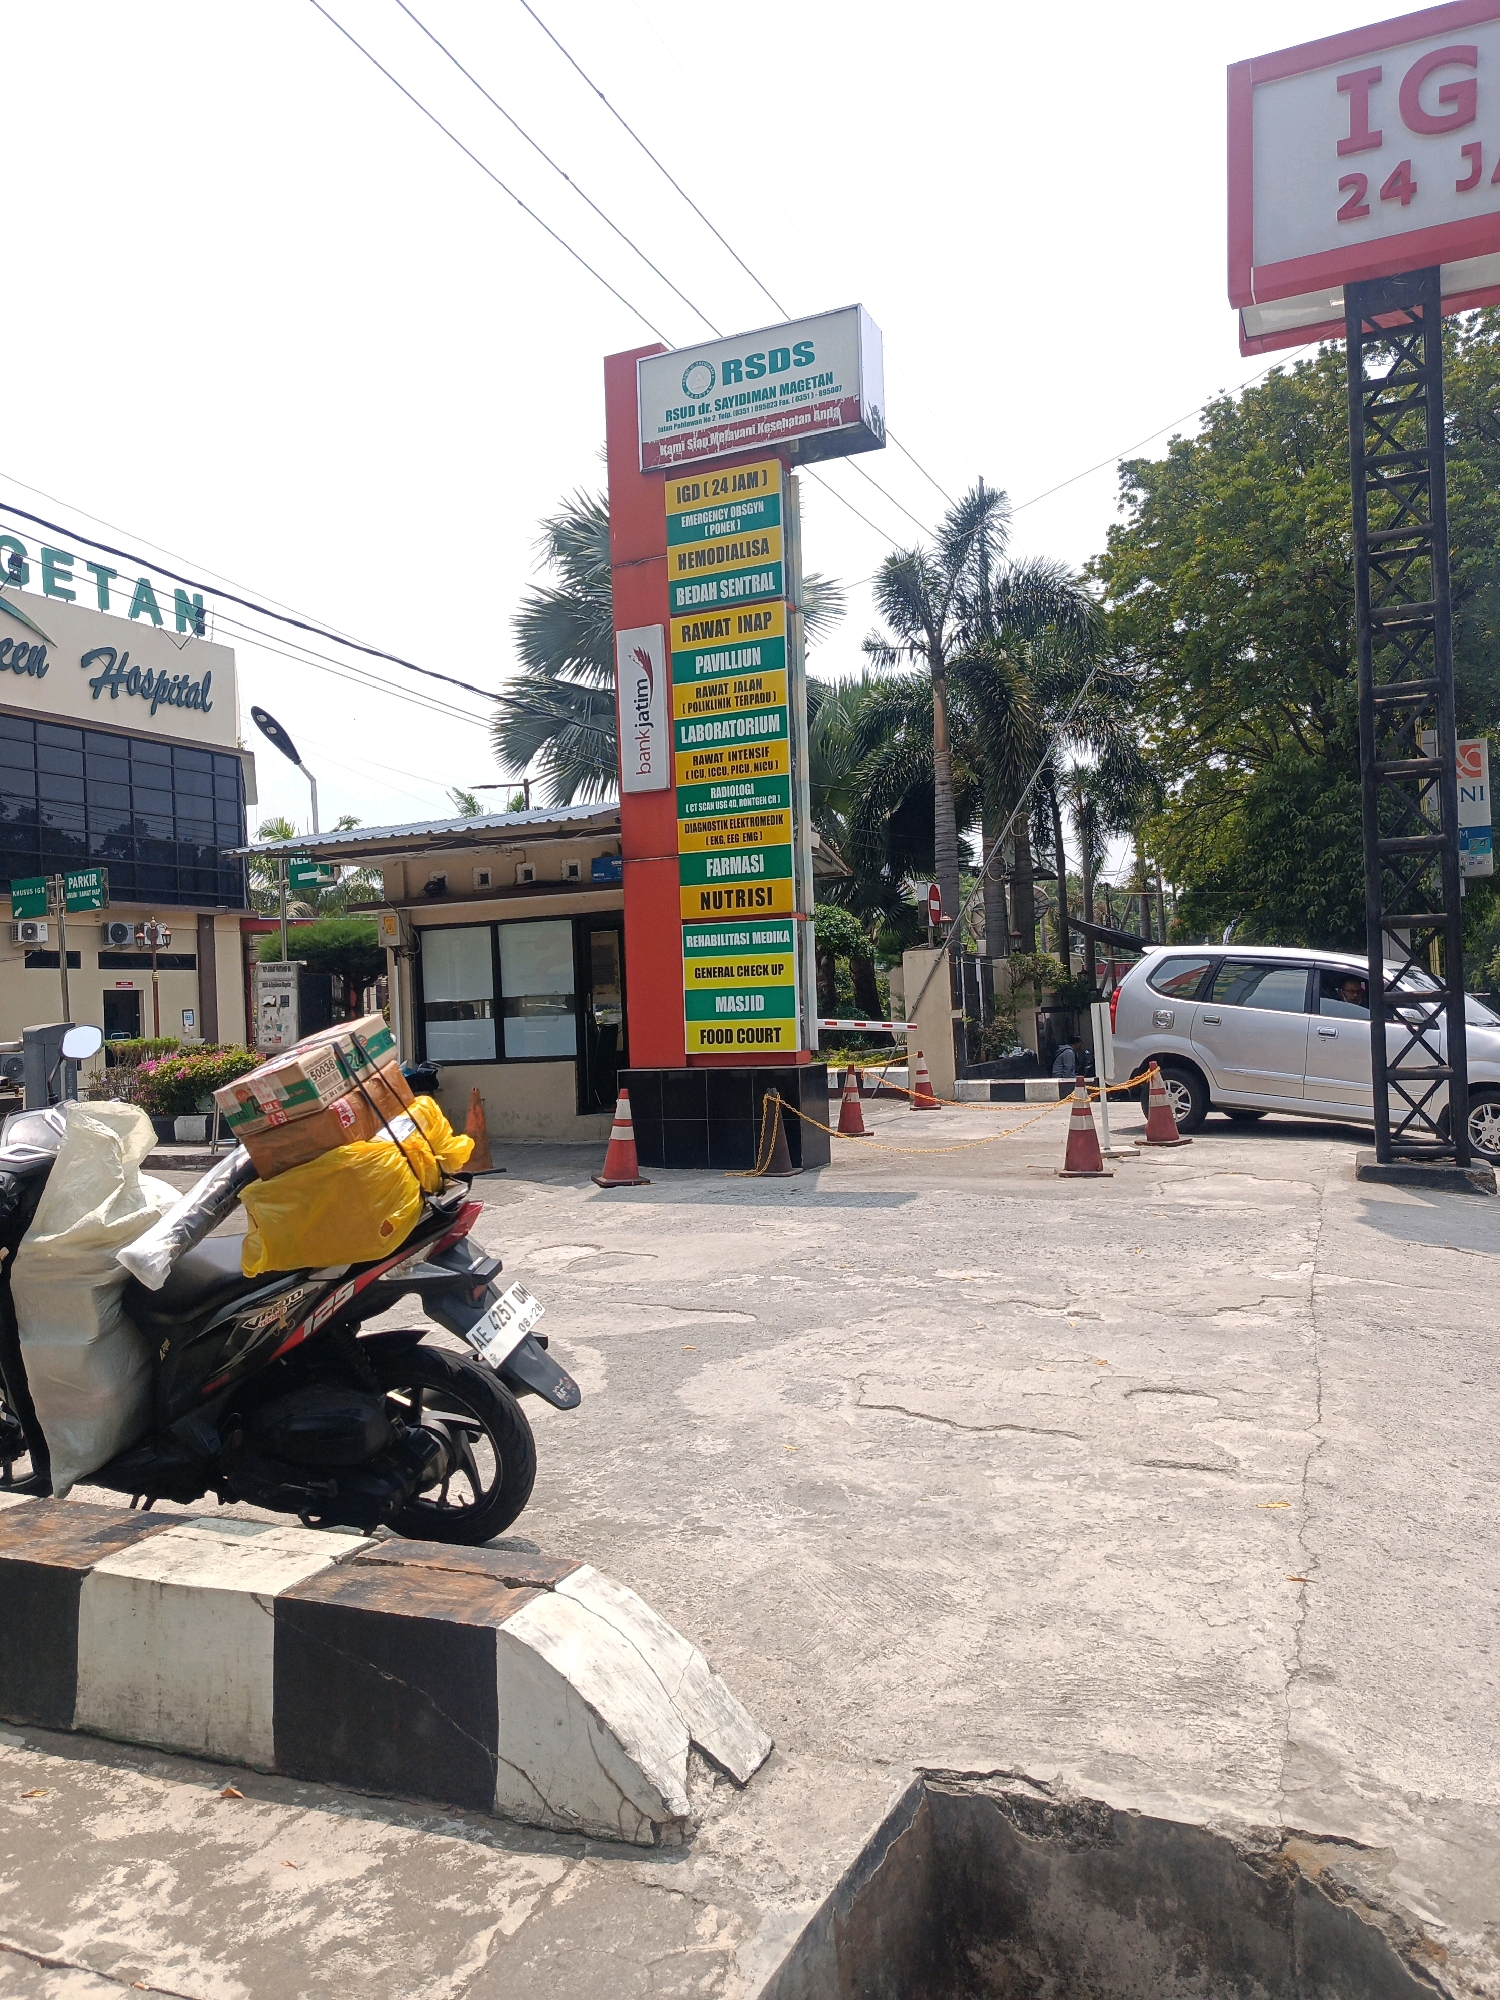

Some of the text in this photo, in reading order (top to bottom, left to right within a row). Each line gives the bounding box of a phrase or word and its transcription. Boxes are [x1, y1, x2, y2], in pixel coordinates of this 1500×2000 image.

[1336, 44, 1479, 157] IG
[1336, 158, 1418, 222] 24
[721, 340, 816, 387] RSDS
[657, 424, 673, 433] Jalan
[703, 416, 711, 424] No
[718, 412, 732, 421] Telp.
[779, 398, 790, 407] Fax.
[818, 385, 843, 397] 895007
[665, 371, 834, 423] RSUD dr. SAYIDIMAN MAGETAN
[676, 483, 700, 504] IGD
[731, 470, 759, 493] JAM
[680, 500, 764, 528] EMERGENCY OBSGYN
[677, 537, 770, 571] HEMODIALISA
[0, 534, 206, 637] GETAN
[676, 571, 776, 606] BEDAH SENTRAL
[681, 611, 773, 643] RAWAT INAP
[695, 646, 762, 675] PAVILLIUN
[80, 647, 213, 716] Hospital
[695, 677, 763, 699] RAWAT JALAN
[680, 713, 780, 744] LABORATORIUM
[692, 746, 770, 766] RAWAT INTENSIF
[708, 766, 730, 777] ICCU,
[730, 763, 753, 775] PICU,
[710, 782, 755, 799] RADIOLOGI
[1459, 785, 1485, 803] NI
[698, 801, 715, 812] SCAN
[715, 799, 728, 810] USG
[738, 796, 767, 808] RONTGEN
[684, 813, 784, 834] DIAGNOSTIK ELEKTROMEDIK
[706, 853, 765, 877] FARMASI
[12, 888, 34, 898] KHUSUS
[68, 873, 98, 890] PARKIR
[700, 886, 773, 911] NUTRISI
[685, 930, 791, 948] REHABILITASI MEDIKA
[694, 963, 785, 979] GENERAL CHECK UP
[715, 994, 765, 1013] MASJID
[699, 1027, 782, 1045] FOOD COURT
[309, 1059, 336, 1081] 50038
[302, 1279, 356, 1338] 125
[471, 1325, 493, 1351] AE
[488, 1299, 517, 1331] 4251
